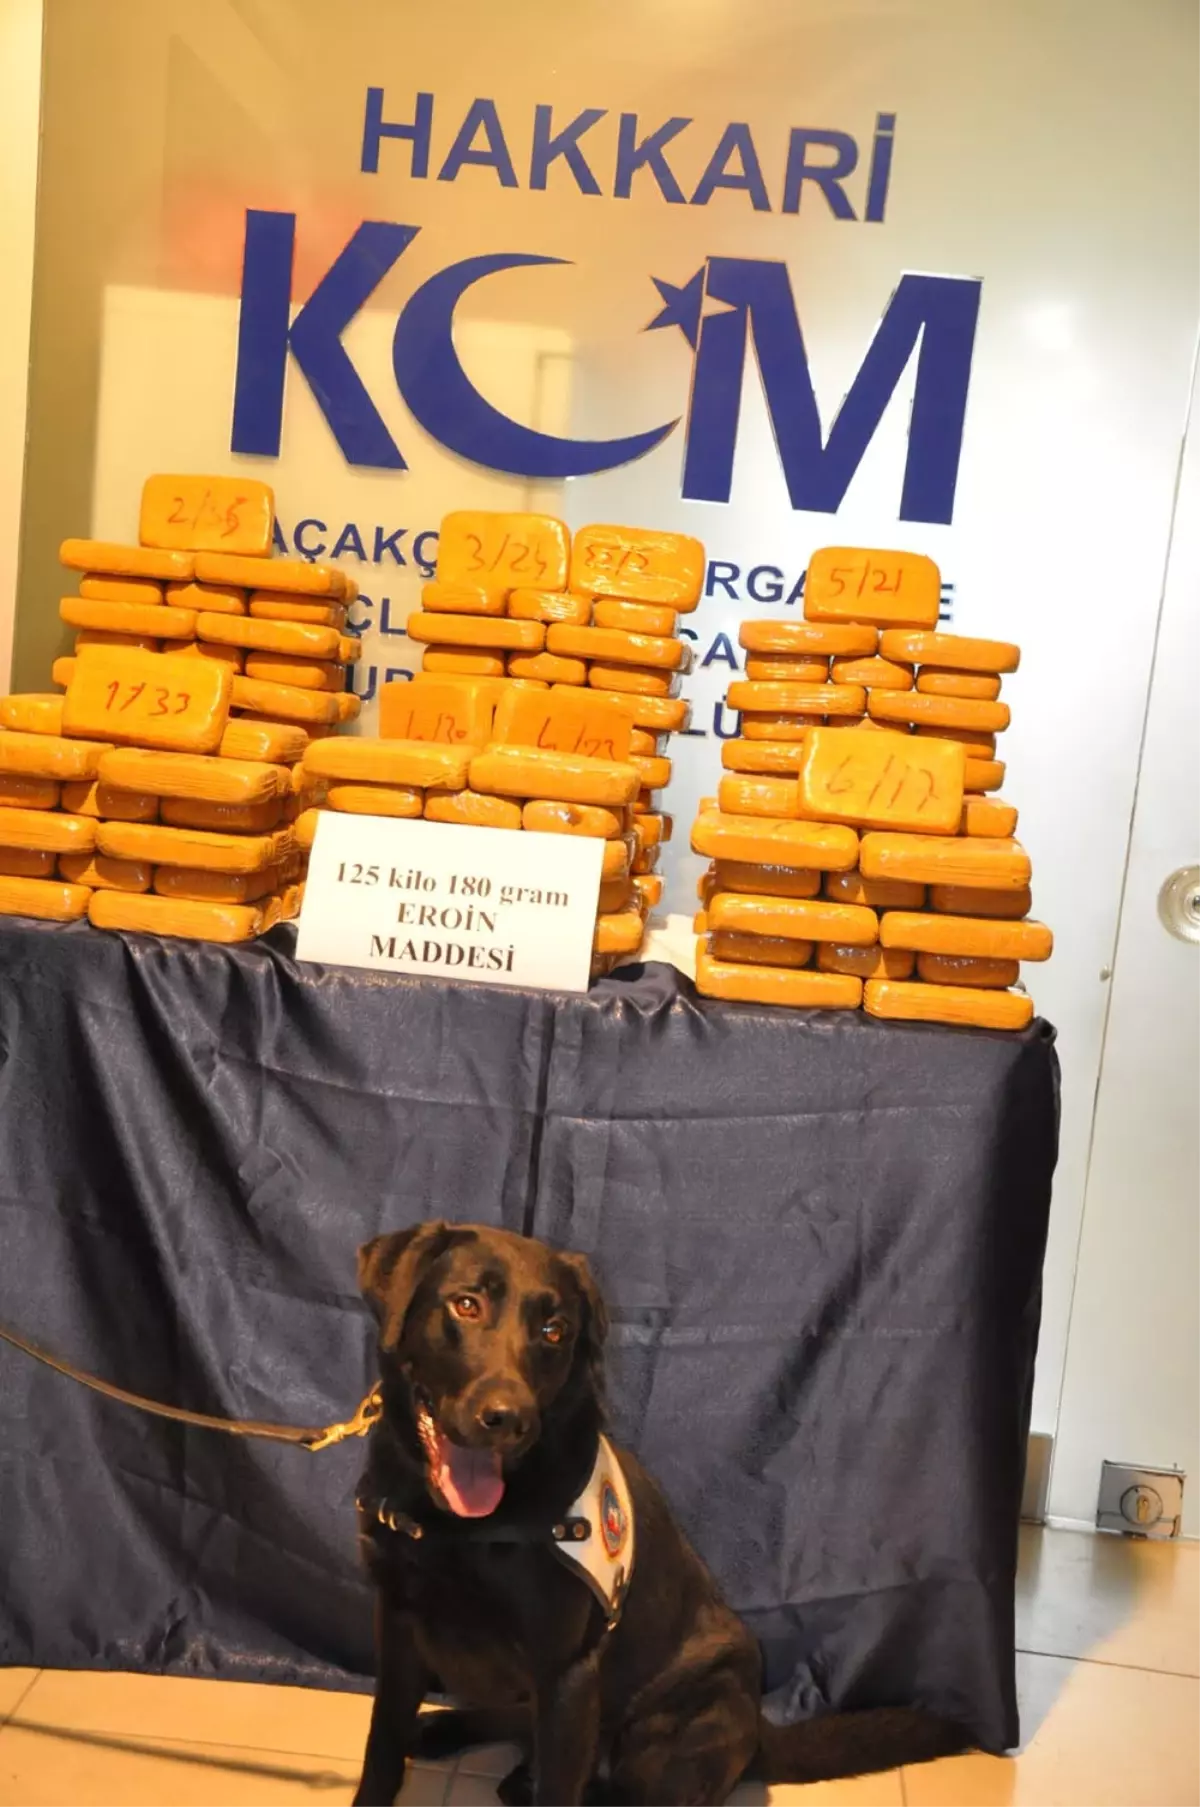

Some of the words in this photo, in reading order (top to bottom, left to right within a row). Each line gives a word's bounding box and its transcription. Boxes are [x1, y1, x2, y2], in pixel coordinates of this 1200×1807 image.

[361, 86, 897, 224] HAKKARİ
[829, 559, 904, 599] 5/21
[336, 862, 380, 886] 125
[388, 867, 437, 893] kilo
[447, 874, 491, 899] 180
[499, 884, 570, 906] gram
[396, 902, 498, 933] EROİN
[369, 934, 515, 972] MADDESİ
